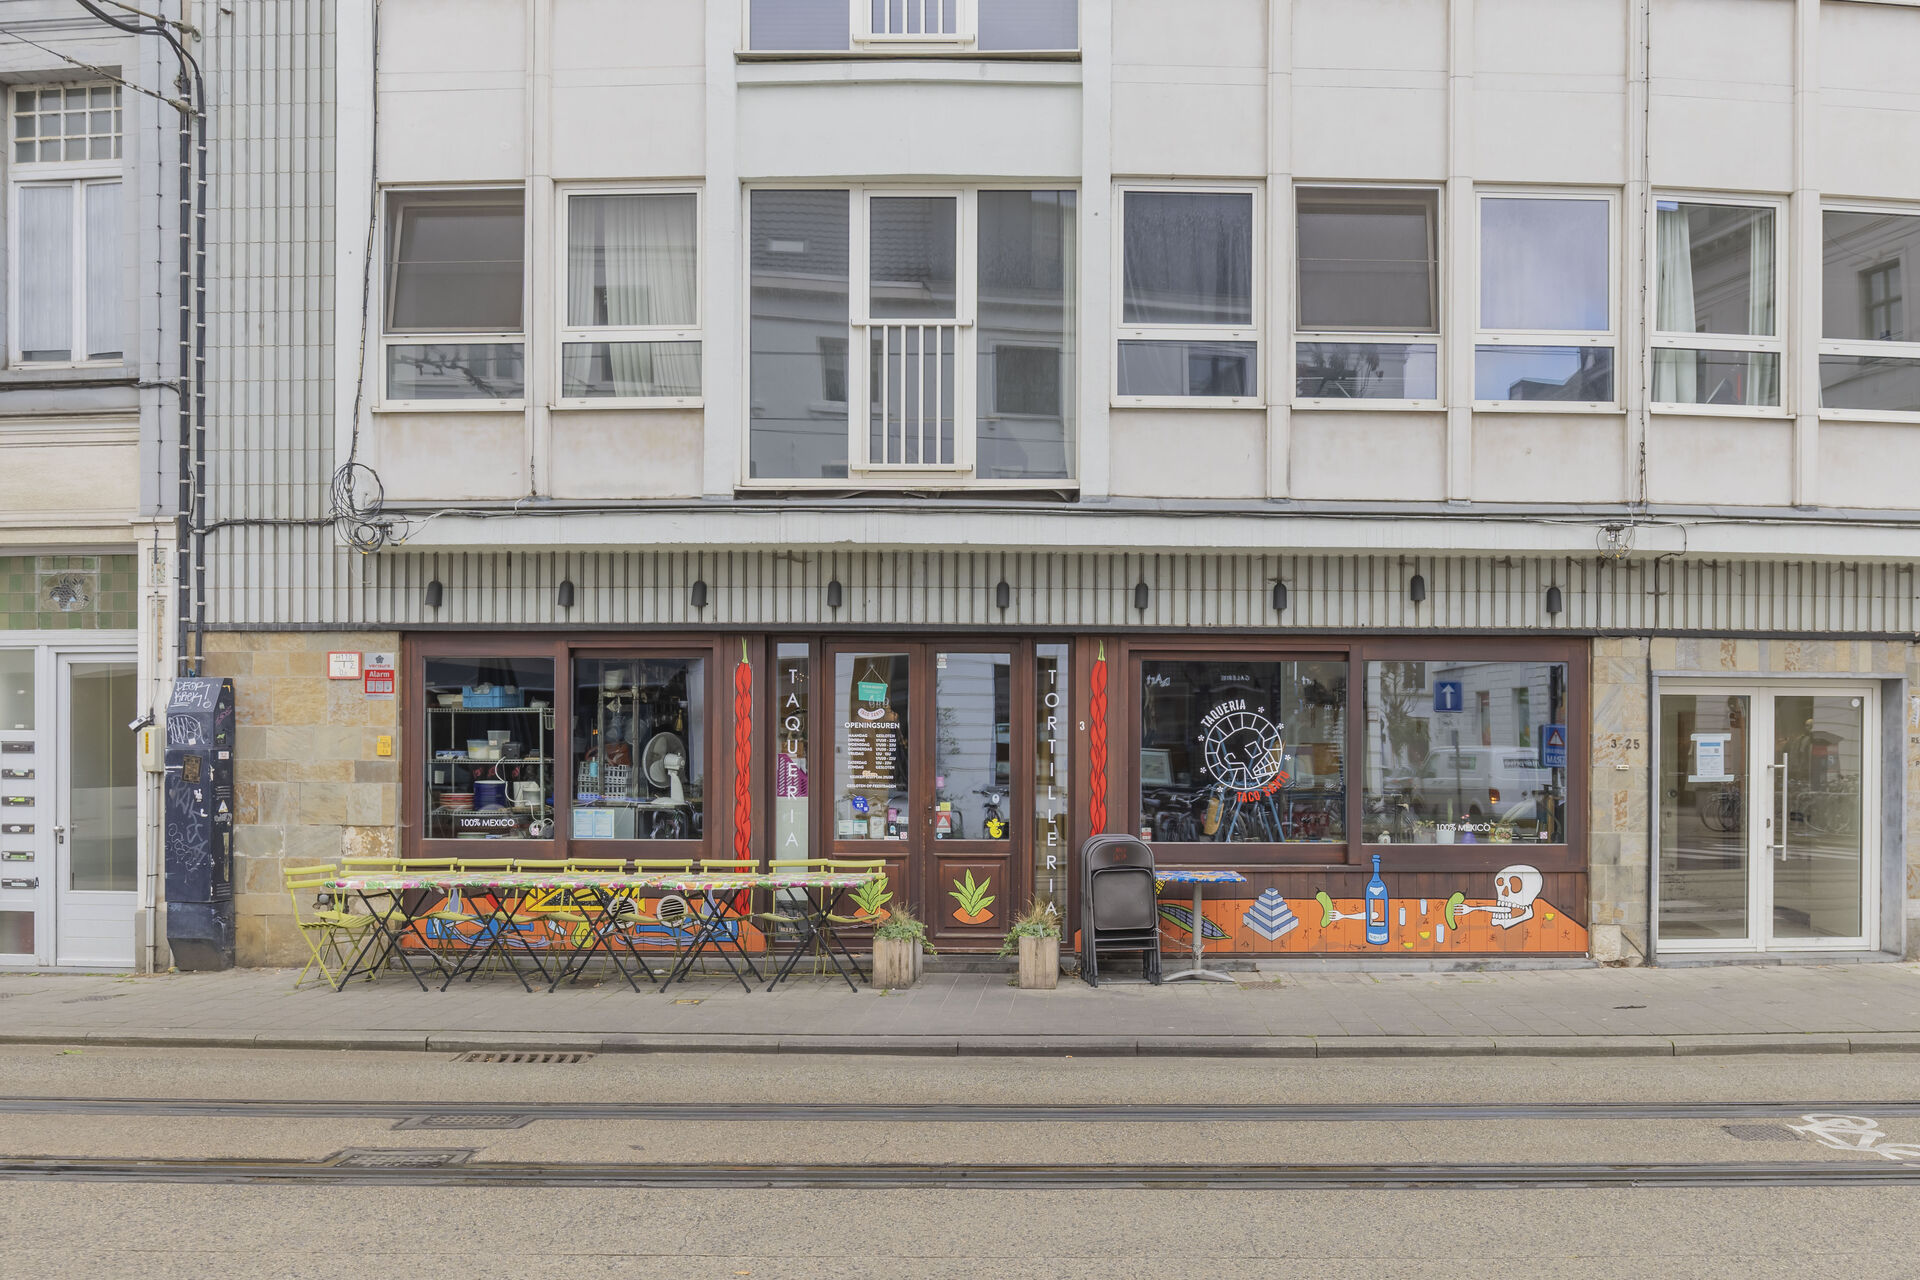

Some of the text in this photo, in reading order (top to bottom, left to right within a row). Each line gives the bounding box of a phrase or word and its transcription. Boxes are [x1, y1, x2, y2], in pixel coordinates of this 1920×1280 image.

[1079, 721, 1086, 731] 3
[1200, 699, 1246, 728] TAQUERIA
[785, 669, 800, 847] TAQUERIA
[1044, 670, 1060, 916] TORTILLERIA
[1236, 771, 1290, 803] TACO SANTO
[460, 818, 515, 827] 100% MEXICO
[1436, 824, 1491, 832] 100% MEXICO
